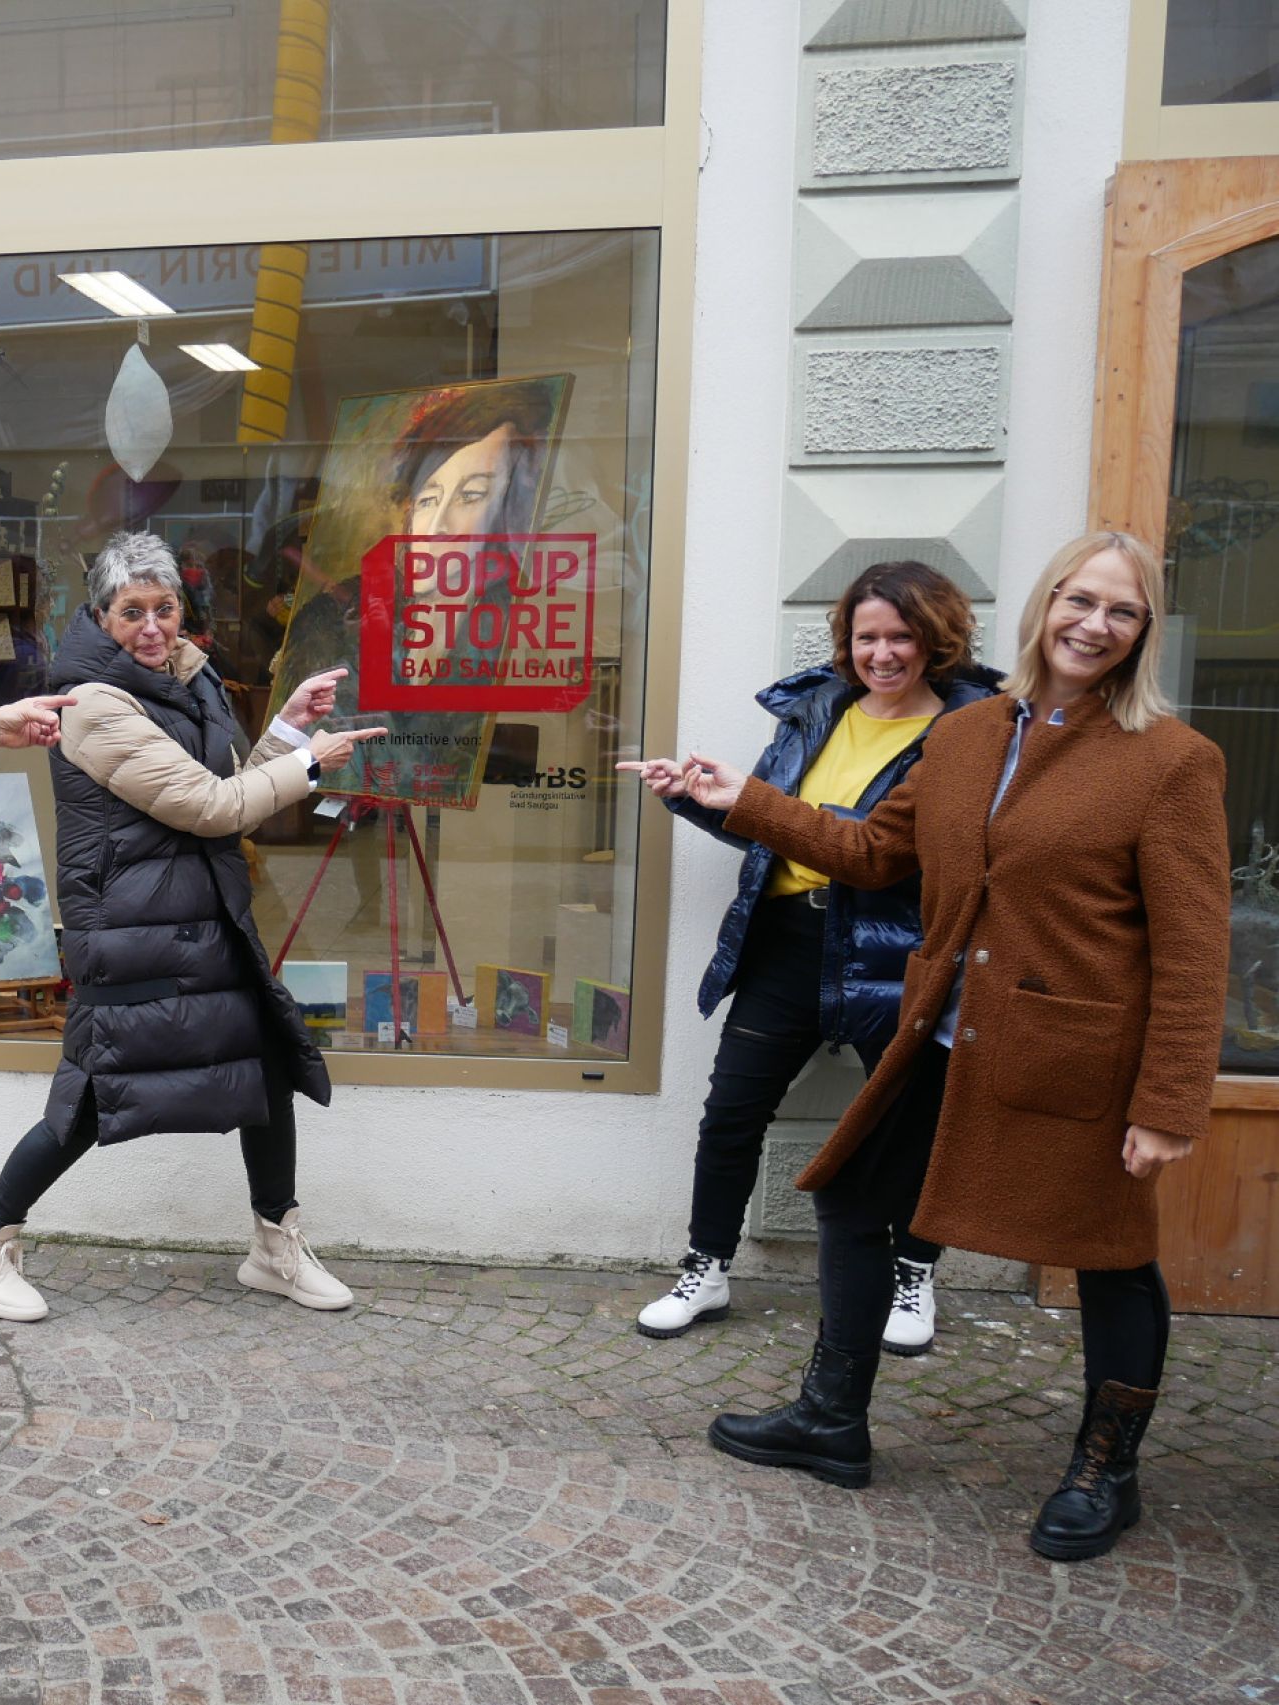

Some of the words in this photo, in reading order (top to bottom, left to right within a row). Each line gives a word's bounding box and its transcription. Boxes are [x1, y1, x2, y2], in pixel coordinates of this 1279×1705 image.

[403, 551, 579, 598] POPUP
[401, 603, 577, 650] STORE
[401, 658, 452, 679] BAD
[460, 658, 575, 679] SAULGAU
[390, 733, 449, 745] Initiative
[413, 764, 459, 777] STADT
[412, 780, 442, 793] BAD
[413, 795, 478, 808] SAULGAU
[510, 801, 525, 809] Bad
